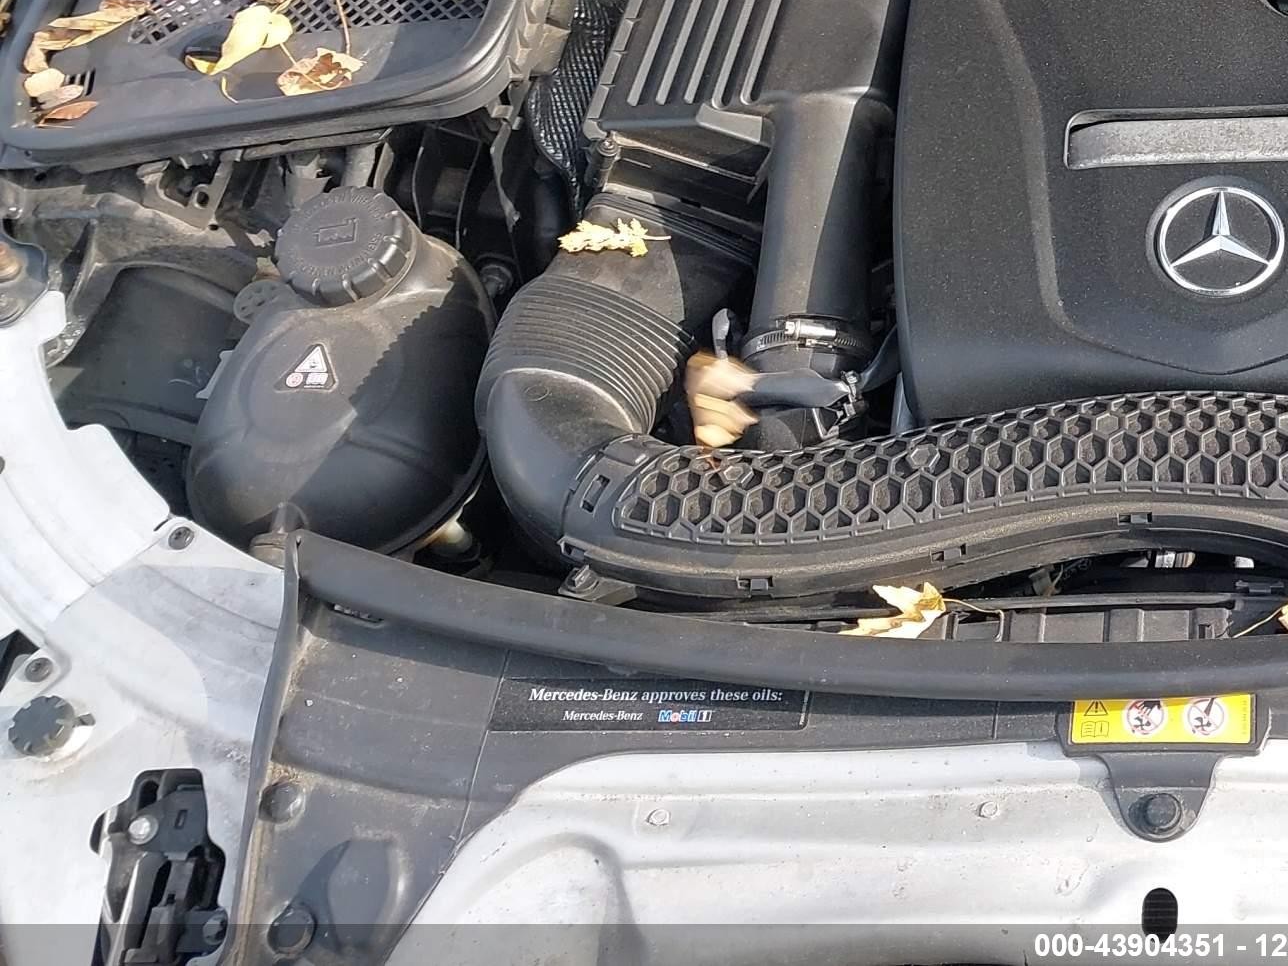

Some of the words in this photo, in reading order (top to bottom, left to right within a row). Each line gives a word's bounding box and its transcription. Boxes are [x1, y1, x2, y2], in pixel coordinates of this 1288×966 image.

[528, 688, 638, 701] Mercedes-Benz
[641, 690, 707, 704] approves
[710, 688, 749, 701] these
[752, 688, 783, 701] oils:
[562, 710, 643, 722] Mercedes-Benz
[658, 710, 697, 723] Mobil
